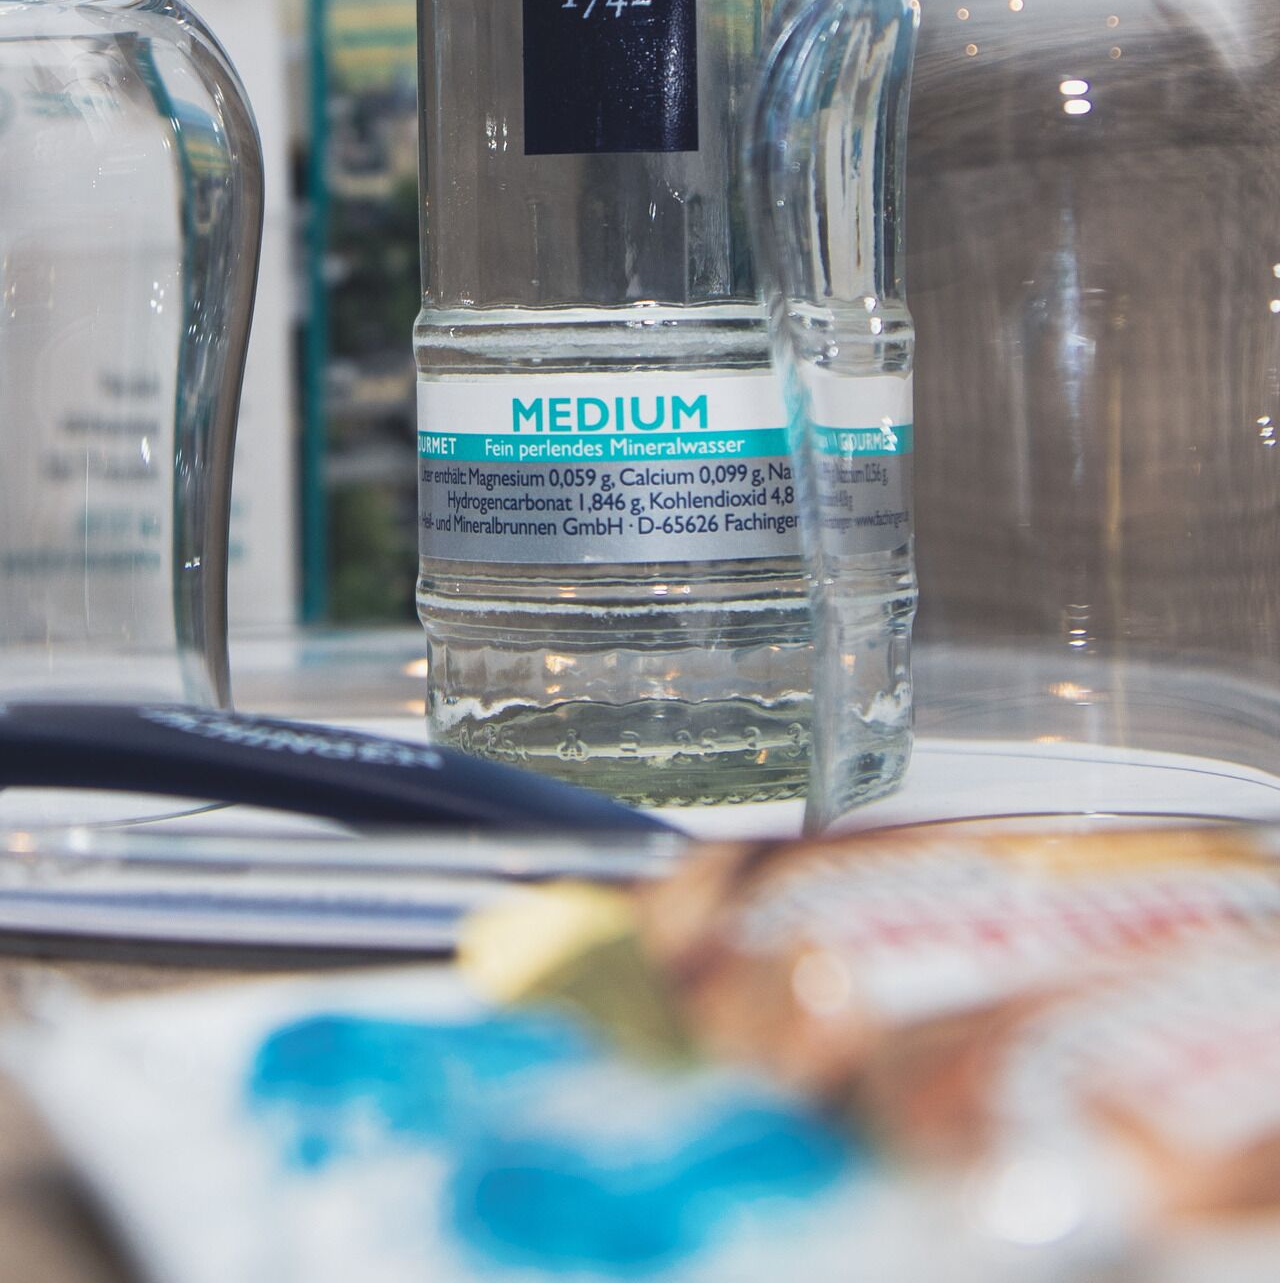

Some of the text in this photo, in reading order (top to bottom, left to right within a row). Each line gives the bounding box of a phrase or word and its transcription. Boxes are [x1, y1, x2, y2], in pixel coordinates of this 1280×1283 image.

[512, 395, 708, 432] MEDIUM
[484, 435, 746, 461] Fein perlendes Mineralwasser
[434, 466, 467, 485] enthält:
[468, 467, 545, 492] Magnesium
[548, 468, 597, 489] 0,059
[600, 476, 616, 493] g,
[619, 468, 695, 487] Calcium
[699, 464, 748, 487] 0,099
[751, 471, 766, 489] g,
[768, 463, 793, 482] Na
[447, 490, 573, 516] Hydrogencarbonat
[578, 492, 626, 514] 1,846
[629, 496, 645, 516] g,
[649, 488, 767, 511] Kohlendioxid
[435, 513, 452, 532] und
[453, 514, 558, 536] Mineralbrunnen
[562, 517, 623, 536] GmbH
[638, 513, 720, 535] D-65626
